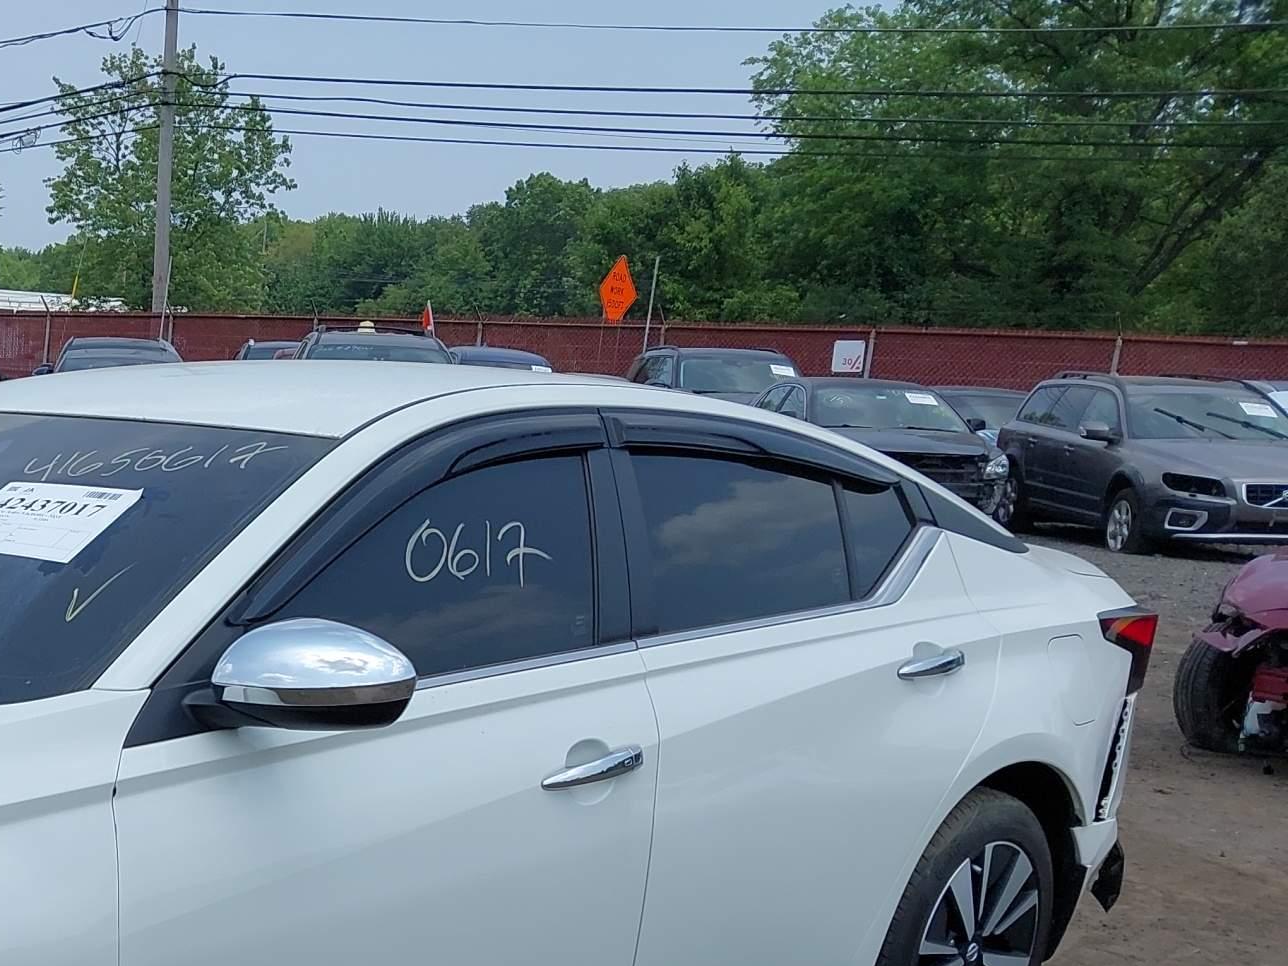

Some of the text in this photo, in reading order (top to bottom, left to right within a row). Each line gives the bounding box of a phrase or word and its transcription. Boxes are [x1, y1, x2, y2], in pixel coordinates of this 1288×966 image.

[612, 271, 627, 282] ROAD
[610, 286, 624, 295] WORK
[405, 518, 553, 588] 0617
